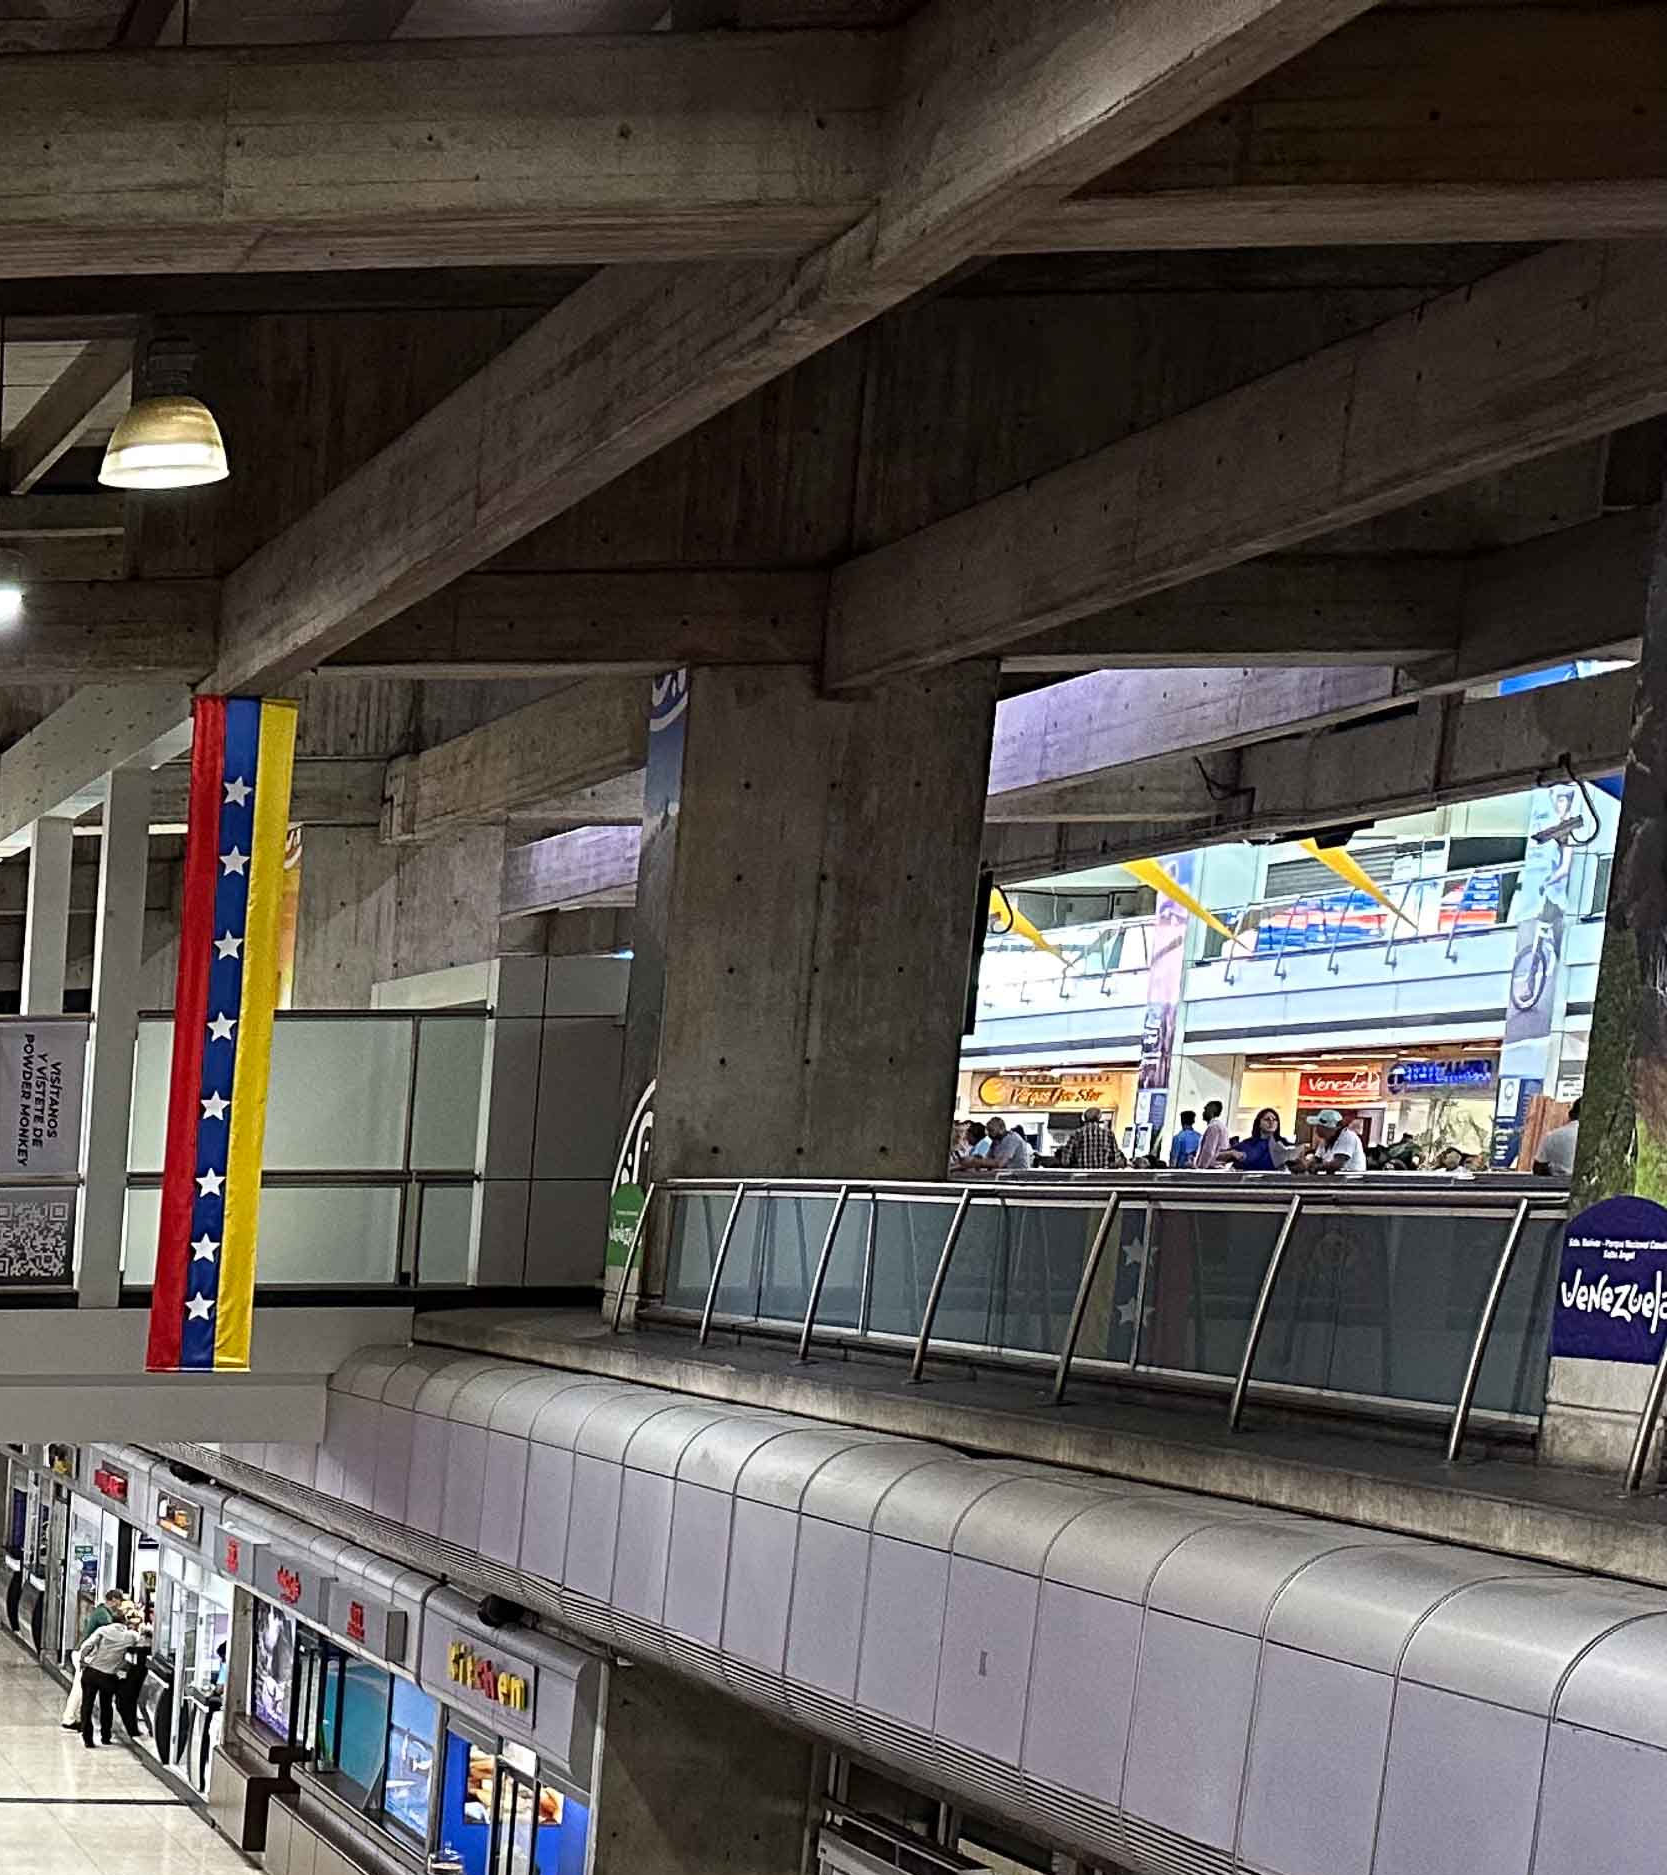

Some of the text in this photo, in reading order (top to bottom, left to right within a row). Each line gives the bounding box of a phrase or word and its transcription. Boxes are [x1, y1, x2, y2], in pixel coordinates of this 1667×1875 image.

[37, 1053, 48, 1062] Y
[17, 1034, 35, 1167] POWDER MONKEY
[32, 1127, 44, 1148] DE
